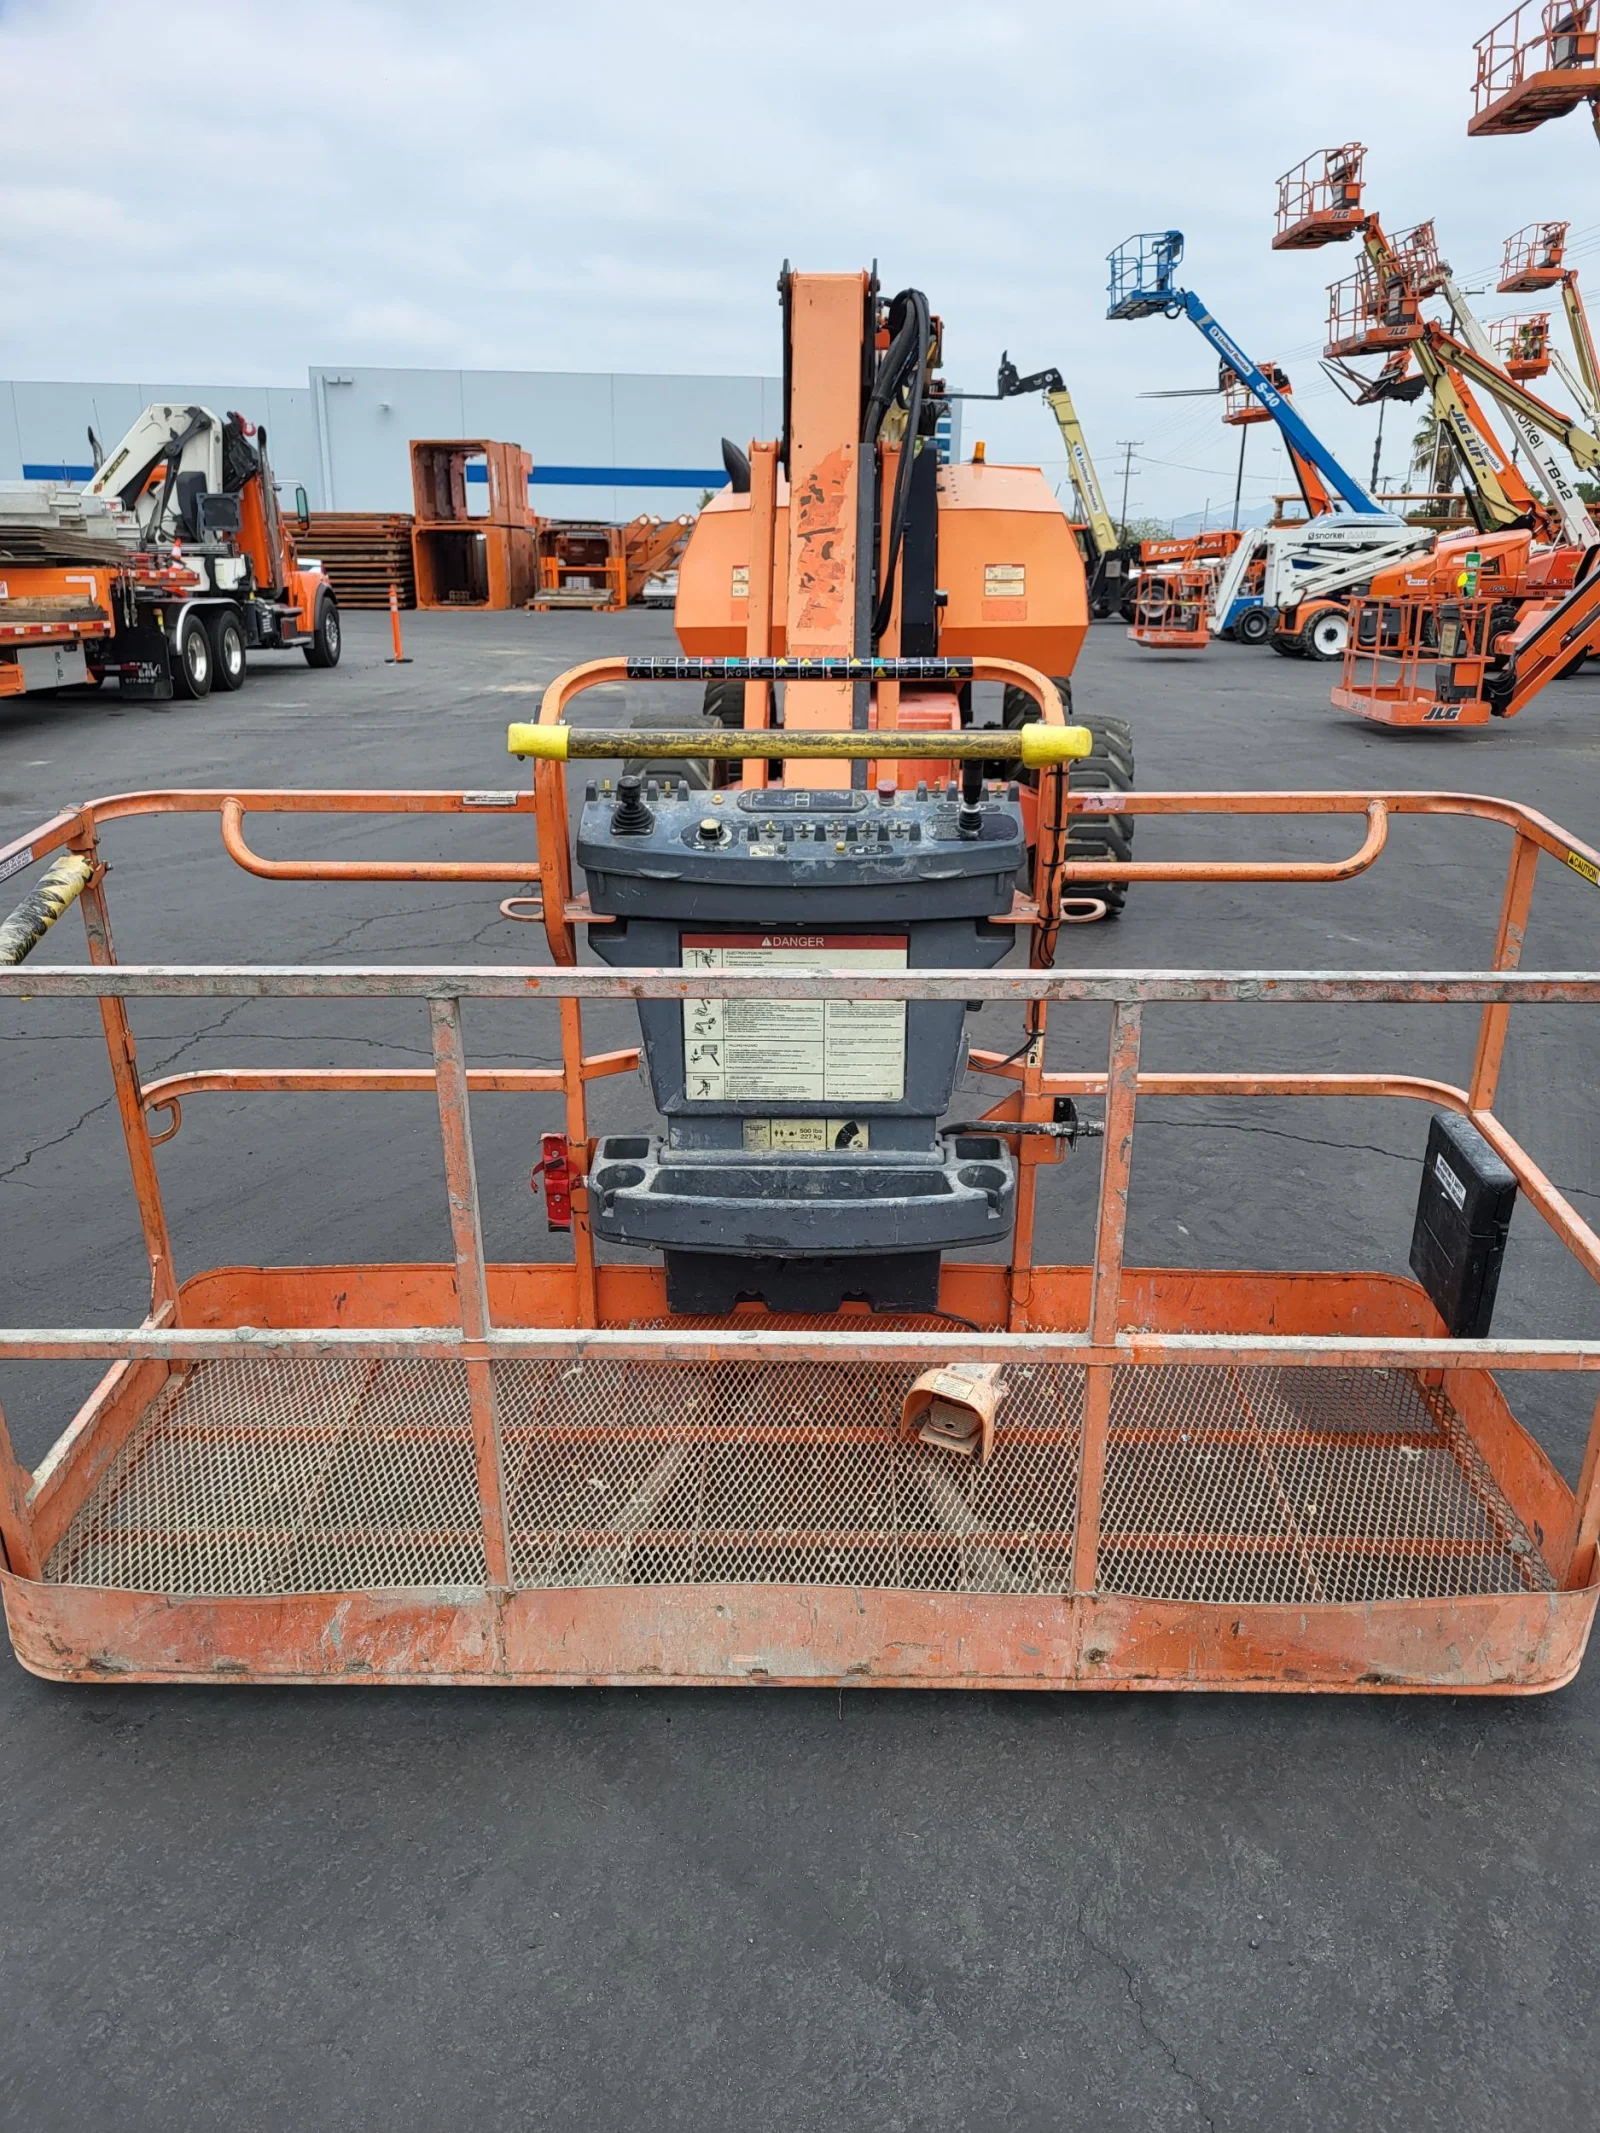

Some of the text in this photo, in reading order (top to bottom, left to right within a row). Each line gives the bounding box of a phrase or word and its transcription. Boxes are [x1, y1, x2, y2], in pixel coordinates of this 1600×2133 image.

[1331, 211, 1349, 219] JLG
[1388, 327, 1407, 336] JLG
[1217, 336, 1251, 373] United Rentals
[1256, 382, 1280, 407] S-40
[1452, 411, 1471, 435] JLG
[1465, 438, 1488, 467] LIFT
[1483, 446, 1501, 470] Rentals
[1078, 458, 1099, 511] United Rentals
[1544, 457, 1572, 501] TB42
[1315, 531, 1345, 539] snorkel
[1423, 707, 1461, 720] JLG
[1574, 857, 1597, 880] CAUTION
[773, 936, 825, 947] DANGER
